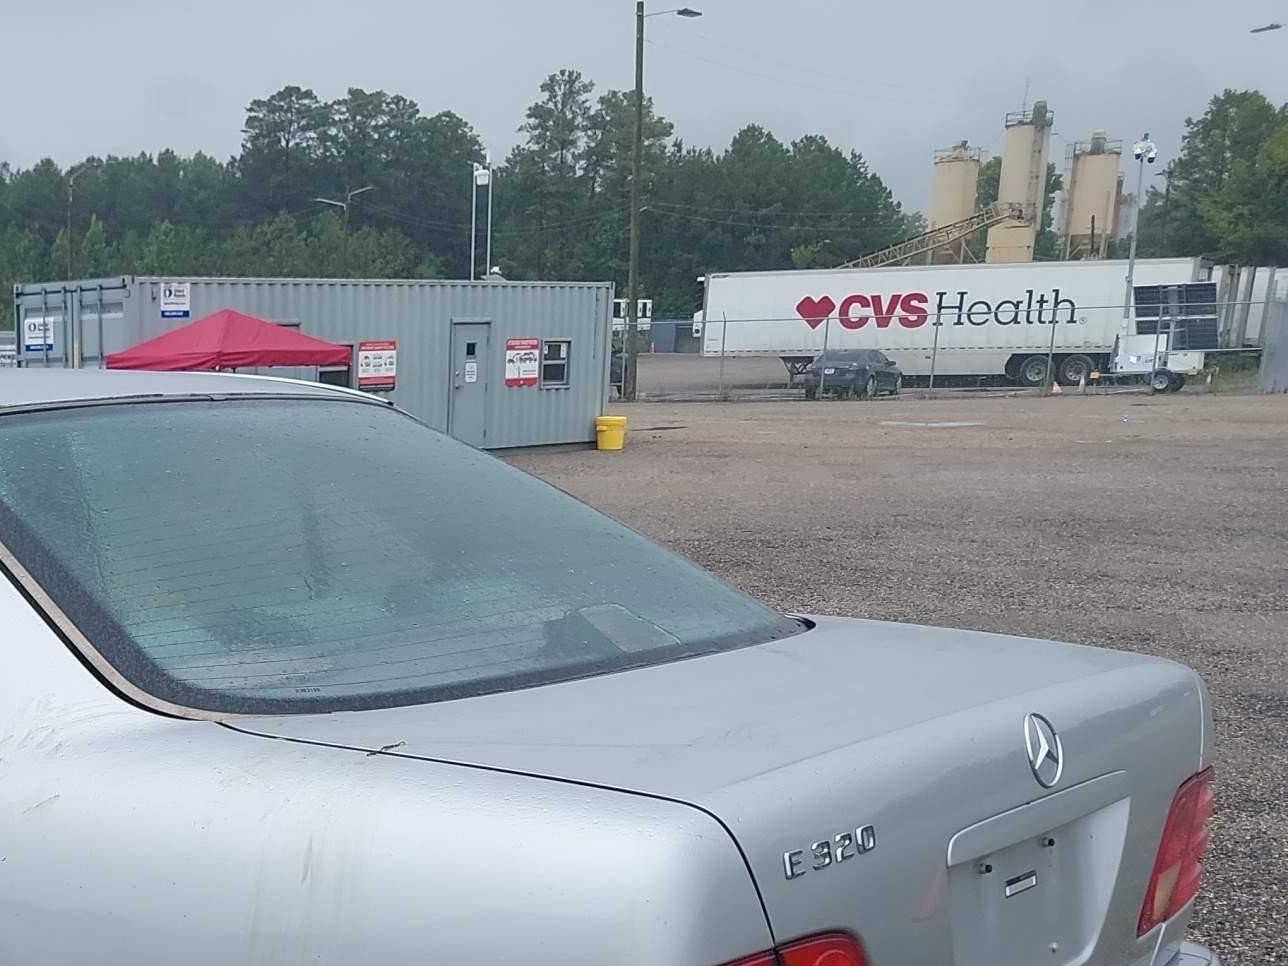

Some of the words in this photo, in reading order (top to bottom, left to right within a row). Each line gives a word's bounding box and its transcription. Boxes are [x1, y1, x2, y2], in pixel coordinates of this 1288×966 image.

[838, 292, 929, 330] CVS
[932, 288, 1078, 327] Health
[783, 849, 807, 880] E
[811, 824, 876, 871] 320
